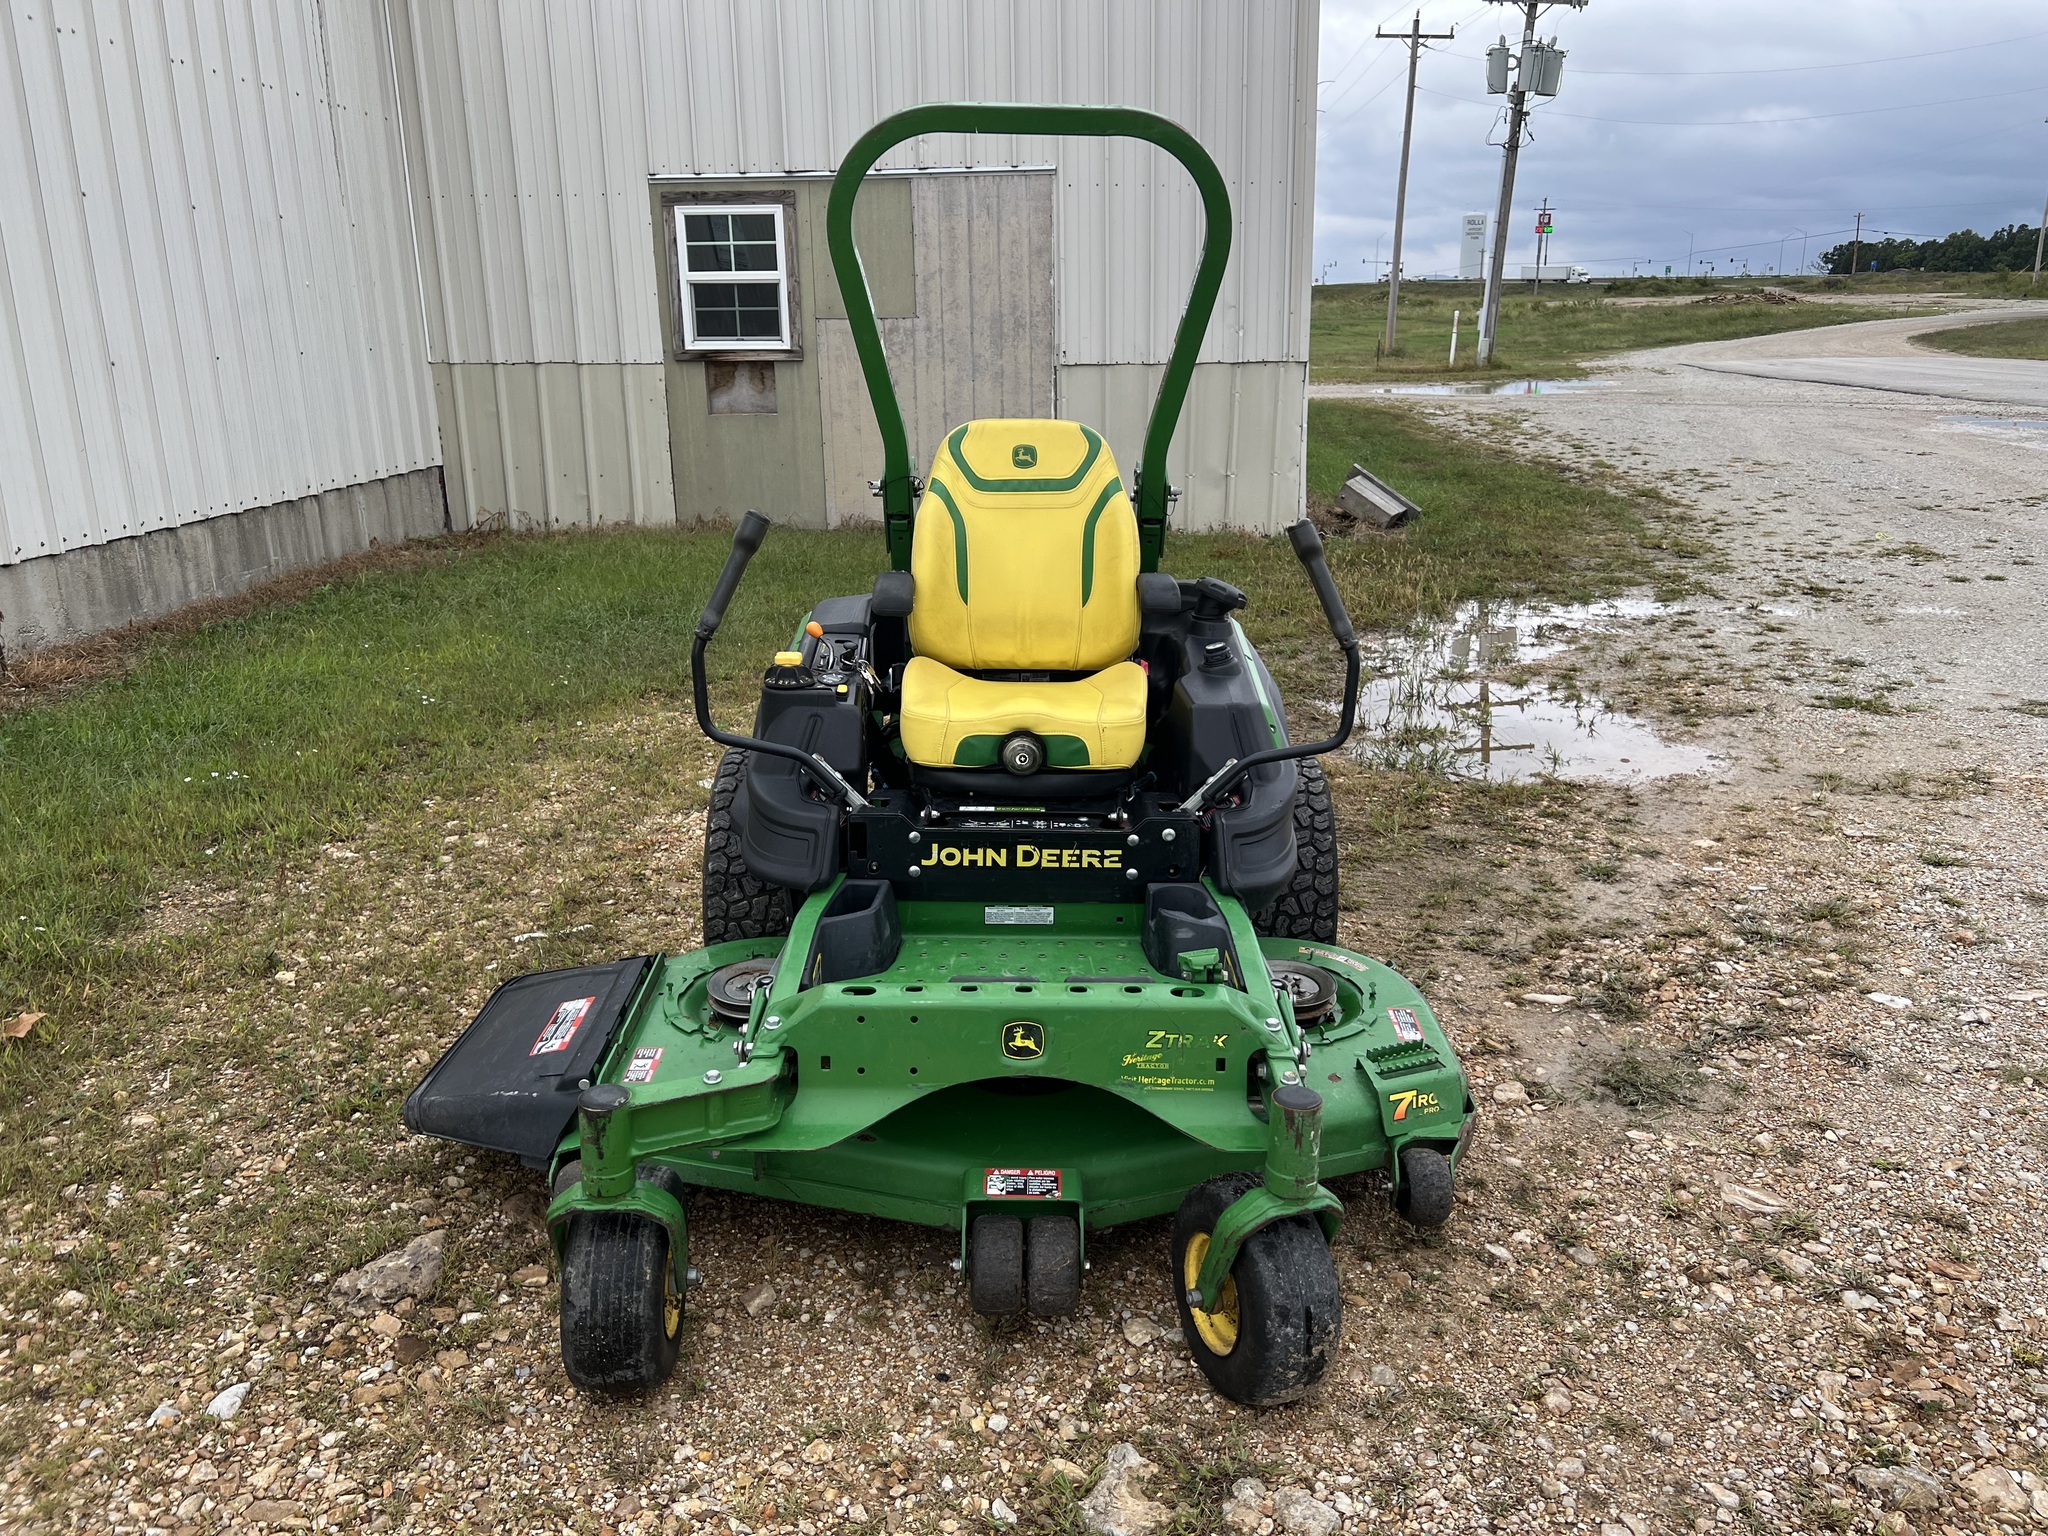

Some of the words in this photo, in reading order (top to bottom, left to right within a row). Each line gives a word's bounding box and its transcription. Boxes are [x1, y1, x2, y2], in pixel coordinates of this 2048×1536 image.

[921, 843, 1007, 867] JOHN
[1016, 844, 1123, 868] DEERE
[1145, 1030, 1229, 1049] ZTRK
[1122, 1053, 1163, 1066] Heritage
[1424, 1105, 1440, 1115] PRO
